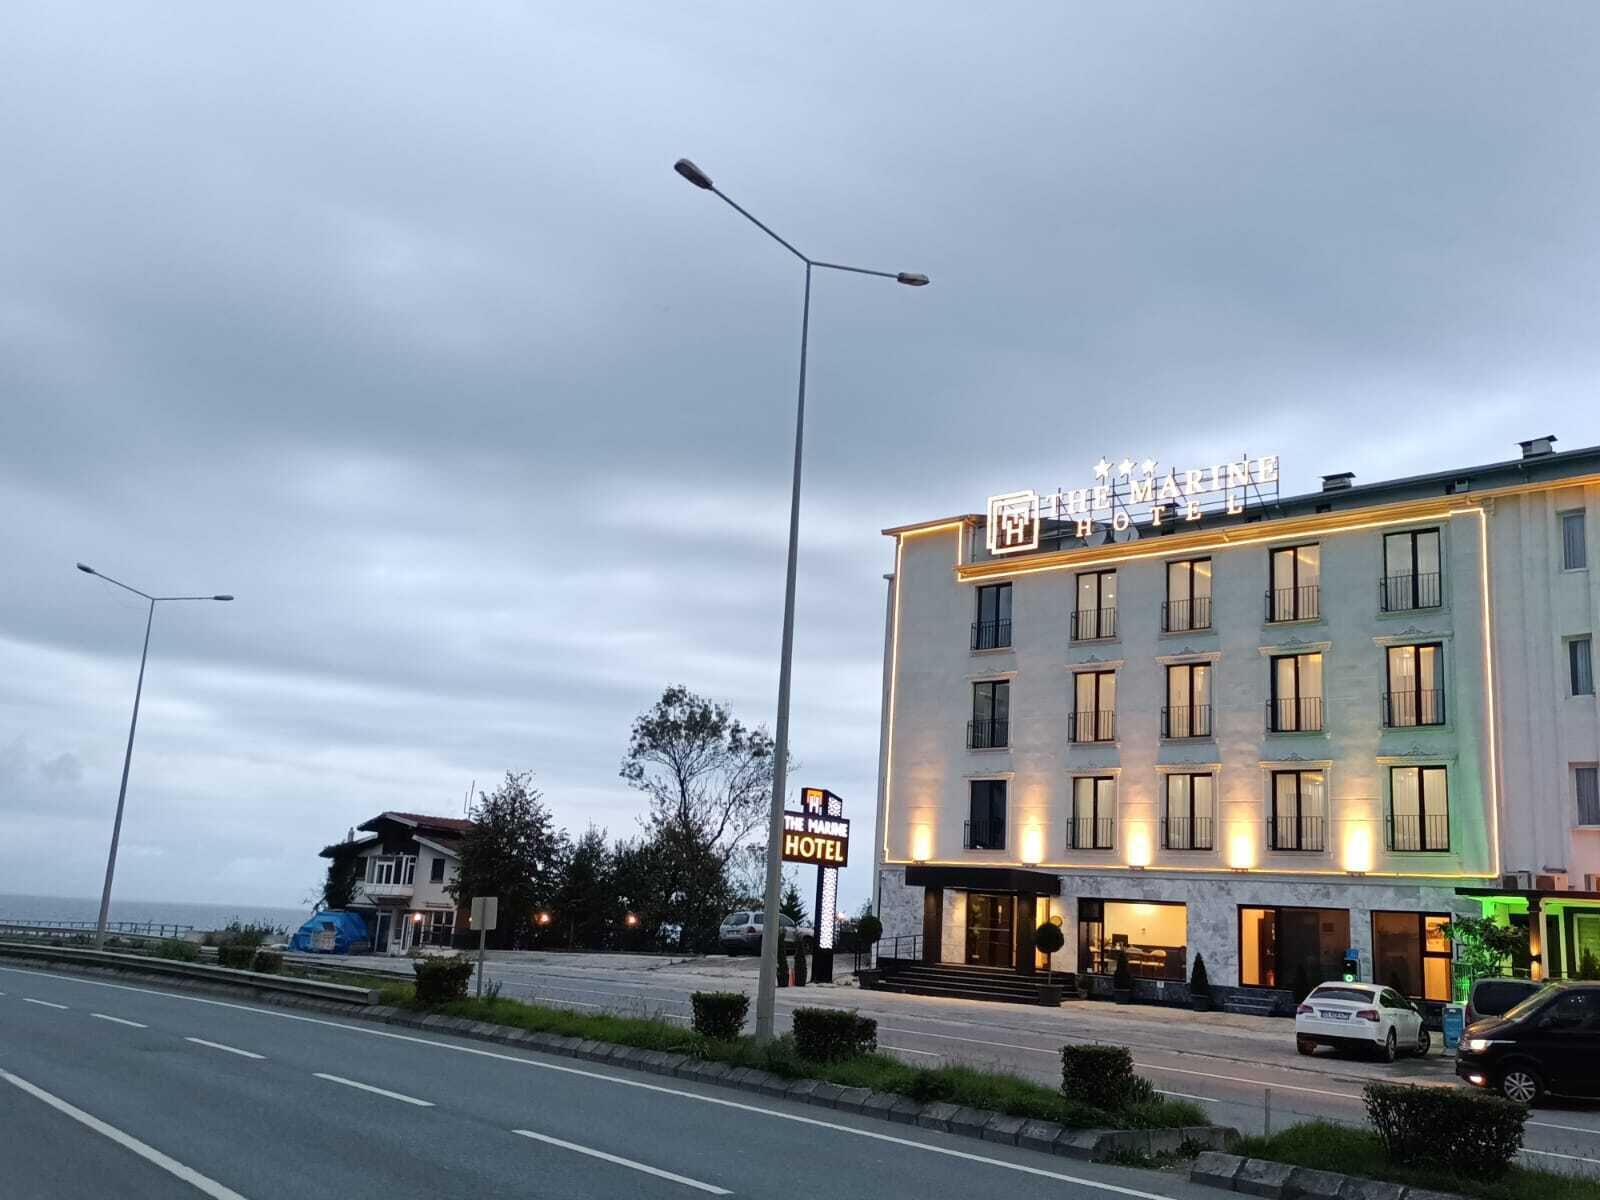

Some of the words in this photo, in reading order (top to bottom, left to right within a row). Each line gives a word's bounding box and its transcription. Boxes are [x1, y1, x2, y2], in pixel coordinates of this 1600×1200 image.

[1045, 484, 1112, 518] THE
[1130, 455, 1279, 505] MARINE
[1076, 494, 1243, 538] HOTEL
[784, 815, 805, 832] THE
[808, 819, 849, 838] MARINE
[785, 834, 844, 862] HOTEL
